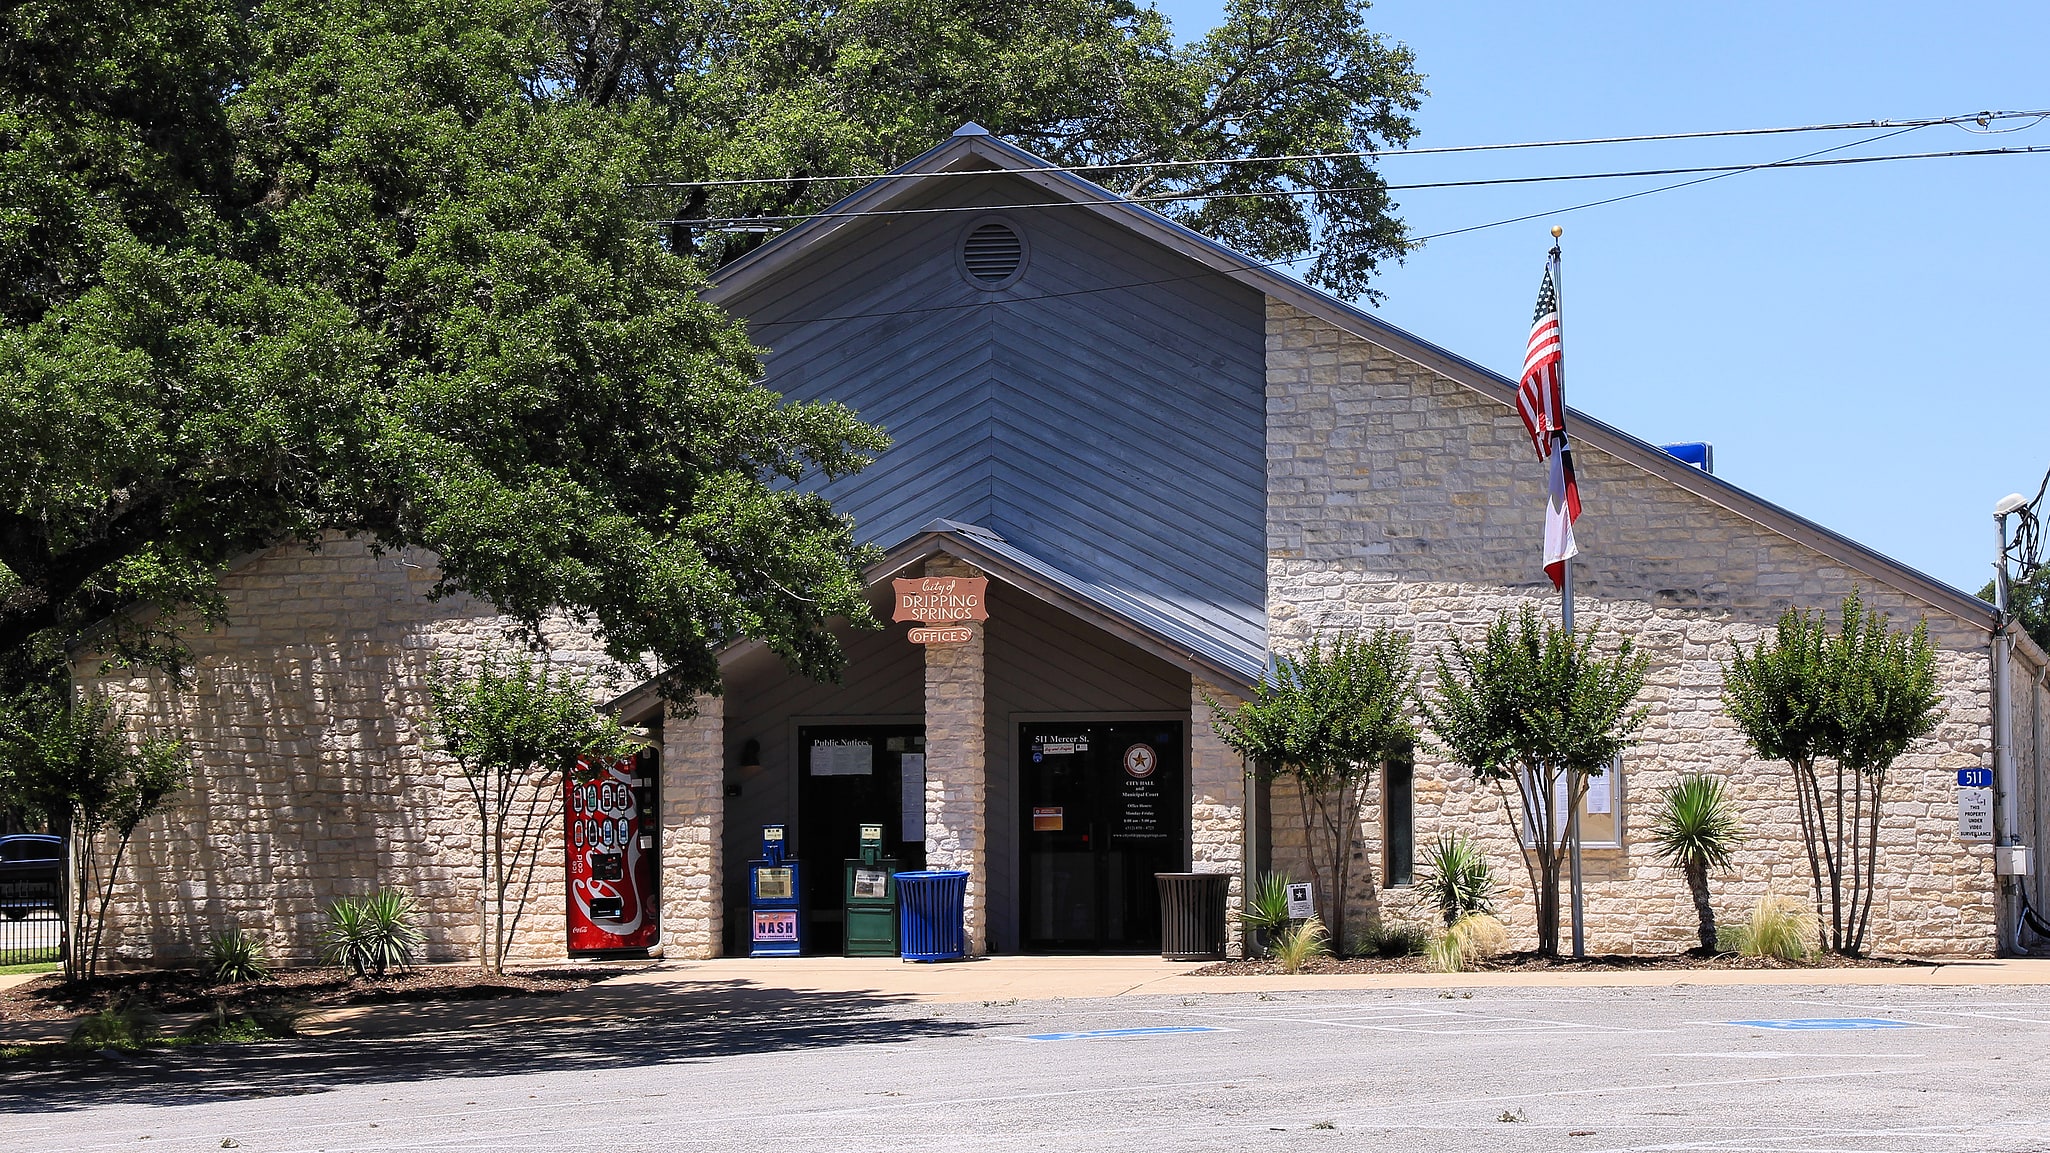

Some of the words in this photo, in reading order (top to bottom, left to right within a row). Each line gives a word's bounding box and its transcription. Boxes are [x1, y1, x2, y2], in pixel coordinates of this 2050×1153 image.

[922, 579, 945, 594] City
[946, 580, 956, 594] of
[903, 594, 978, 608] DRIPPING
[912, 608, 972, 620] SPRINGS
[913, 632, 968, 642] OFFICES
[1966, 771, 1982, 784] 511
[758, 922, 793, 934] NASH
